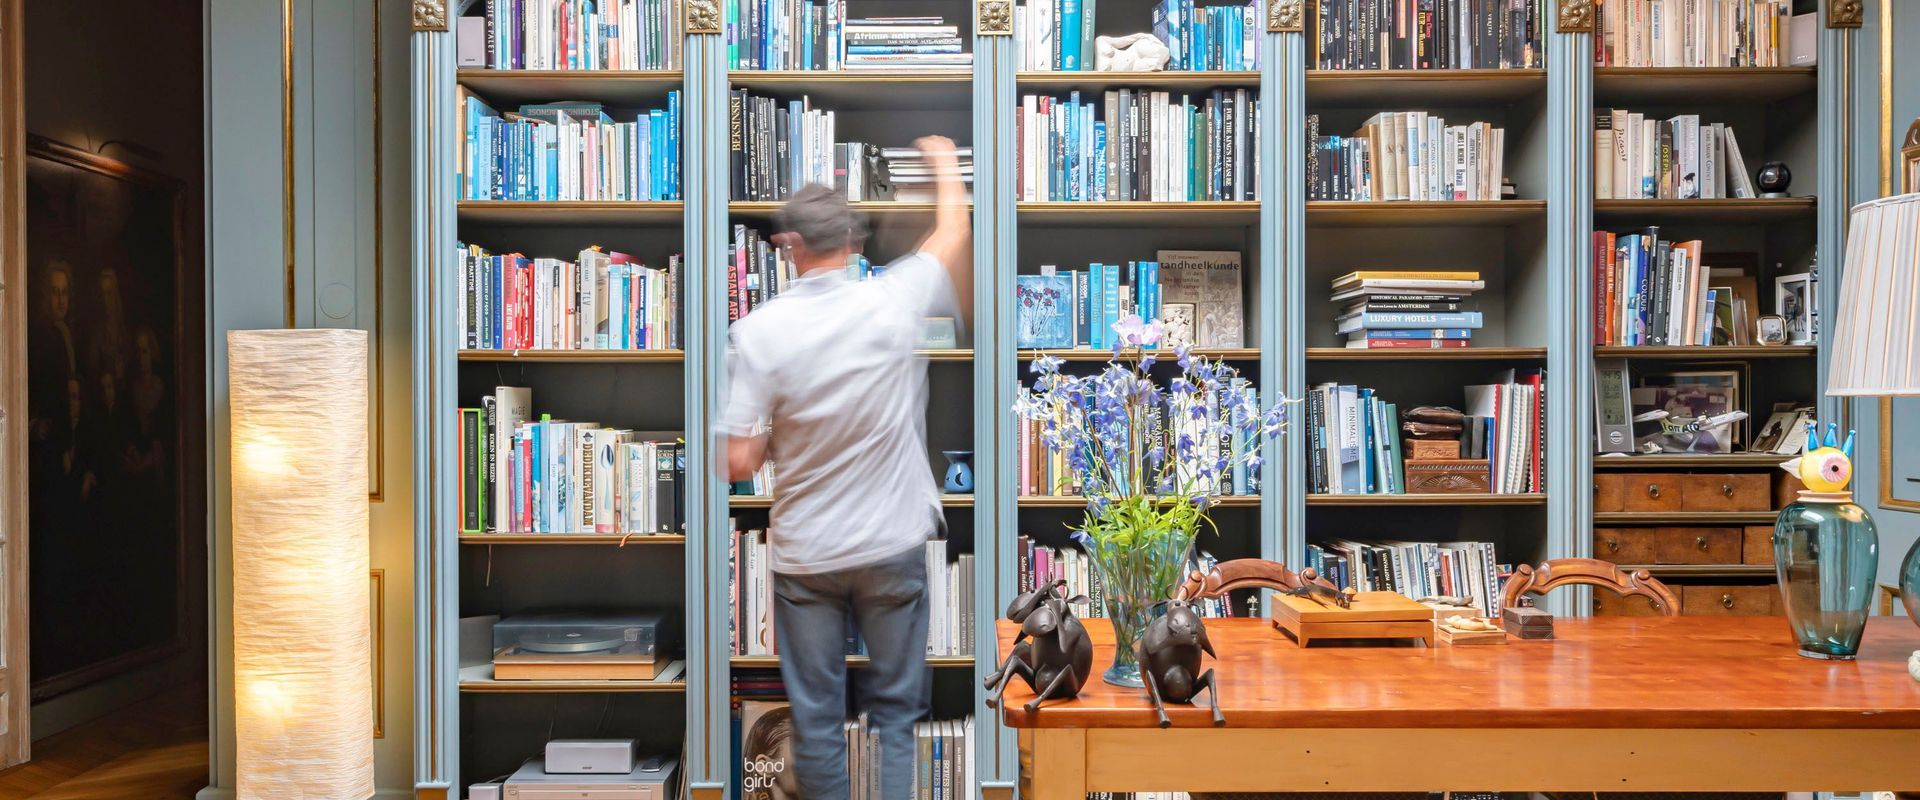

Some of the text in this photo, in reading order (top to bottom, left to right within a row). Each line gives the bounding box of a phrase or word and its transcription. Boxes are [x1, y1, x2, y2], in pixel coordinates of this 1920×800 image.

[731, 96, 741, 151] BEKSINSKI
[1160, 260, 1241, 271] tandheelkunde
[582, 290, 592, 306] TLV
[729, 265, 739, 321] ASIAN ART
[1640, 278, 1649, 312] COLOUR
[1370, 314, 1437, 323] LUXURY HOTELS
[1220, 434, 1231, 448] OF
[1349, 406, 1357, 461] MINIMALISME
[489, 453, 495, 461] EN
[582, 443, 594, 526] DEDIKKEVANDAM
[744, 757, 785, 773] bond
[942, 759, 950, 787] BRONZES
[744, 772, 776, 792] girls
